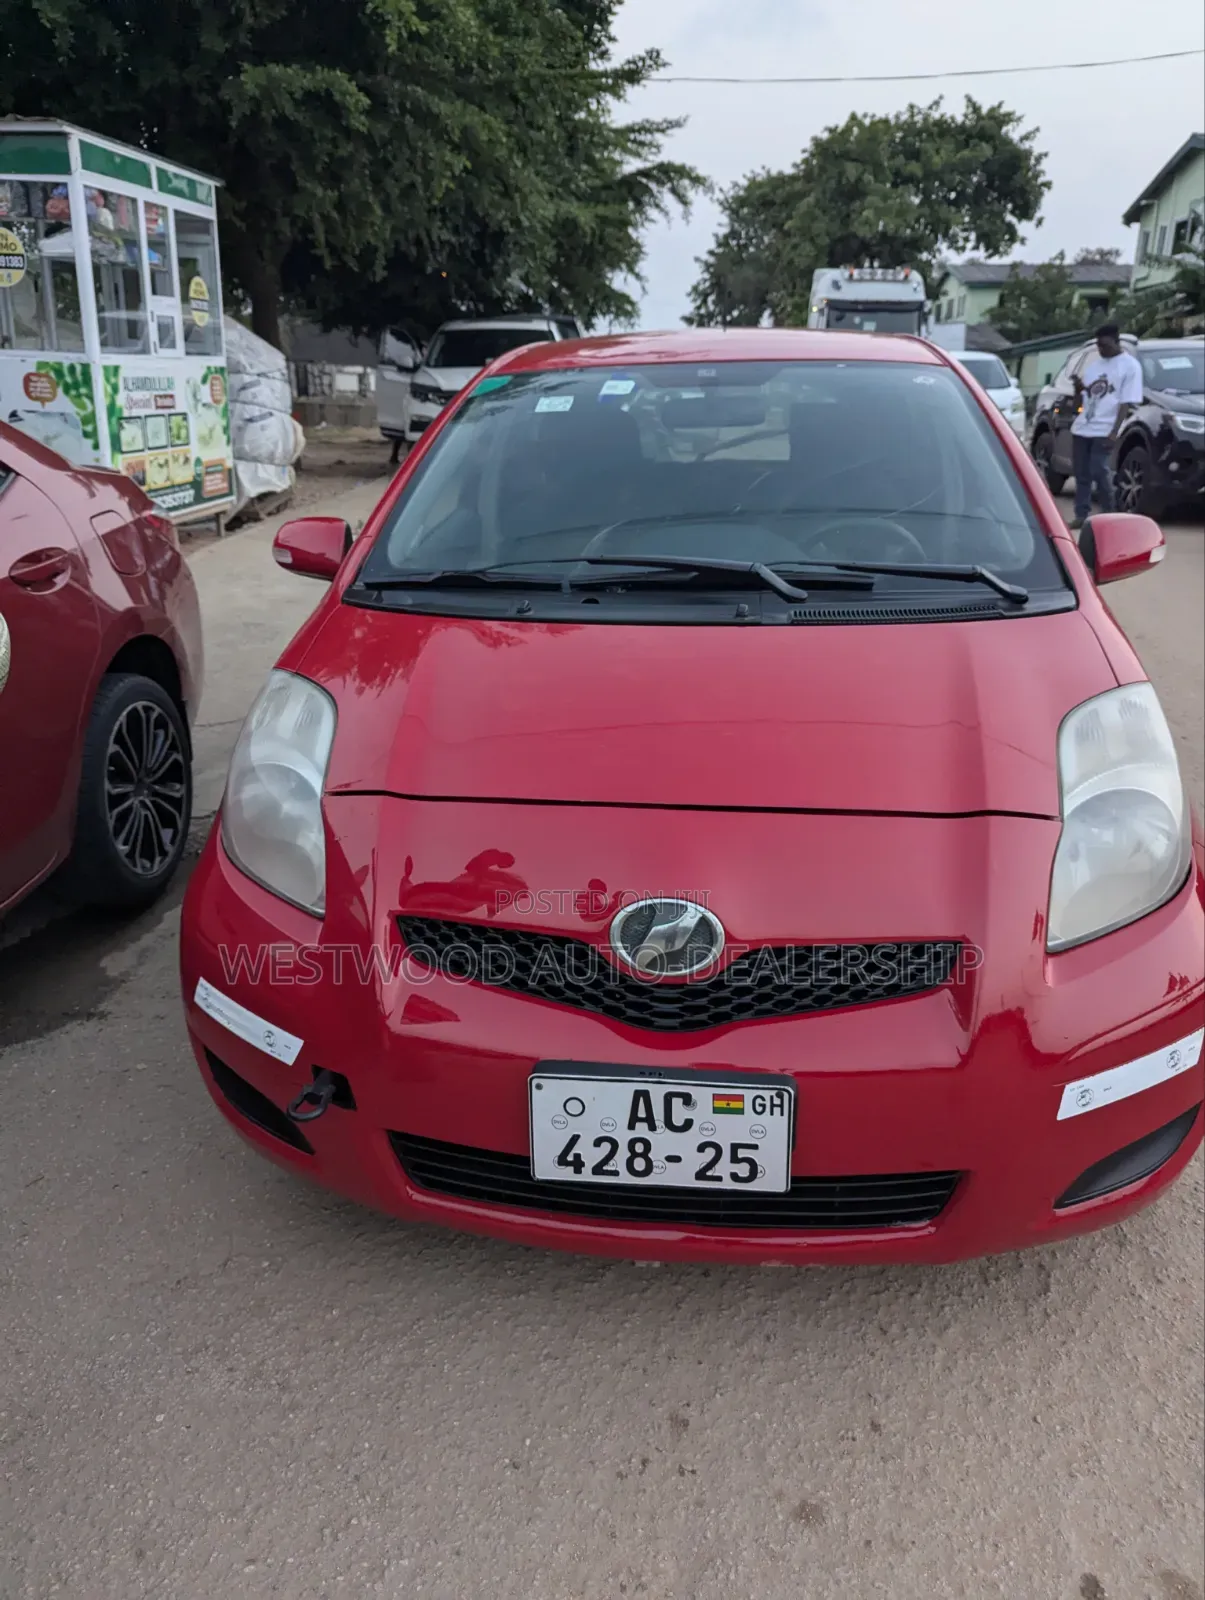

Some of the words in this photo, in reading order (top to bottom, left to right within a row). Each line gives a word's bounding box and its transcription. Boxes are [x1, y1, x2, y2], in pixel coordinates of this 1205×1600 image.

[627, 1089, 694, 1133] AC
[751, 1092, 785, 1117] GH
[557, 1133, 760, 1184] 428-25
